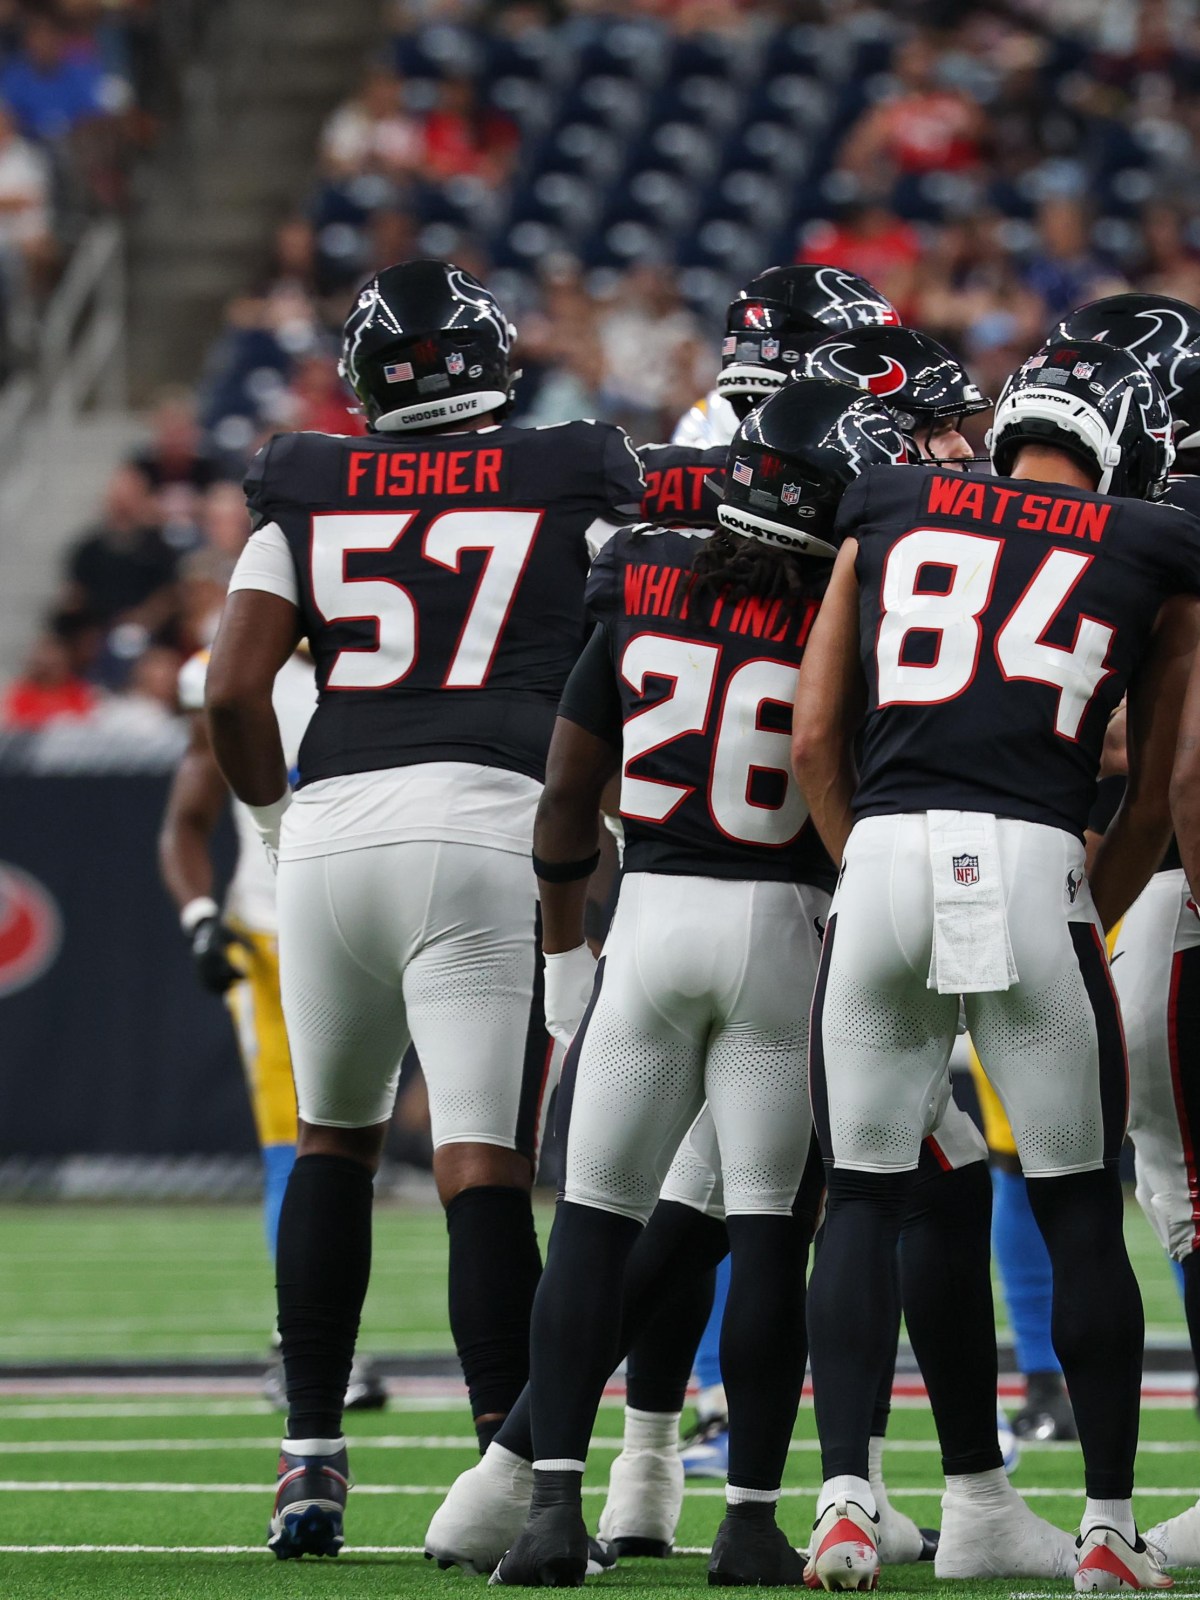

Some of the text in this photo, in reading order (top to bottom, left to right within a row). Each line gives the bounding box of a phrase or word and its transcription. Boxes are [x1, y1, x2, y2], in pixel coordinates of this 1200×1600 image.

[401, 399, 478, 425] CHOOSE LOVE
[347, 448, 503, 497] FISHER
[641, 466, 728, 522] PAT
[720, 513, 809, 550] HOUSTON
[927, 475, 1112, 543] WATSON
[309, 506, 547, 691] 57
[875, 525, 1119, 744] 84
[618, 629, 812, 849] 26
[956, 867, 978, 884] NFL
